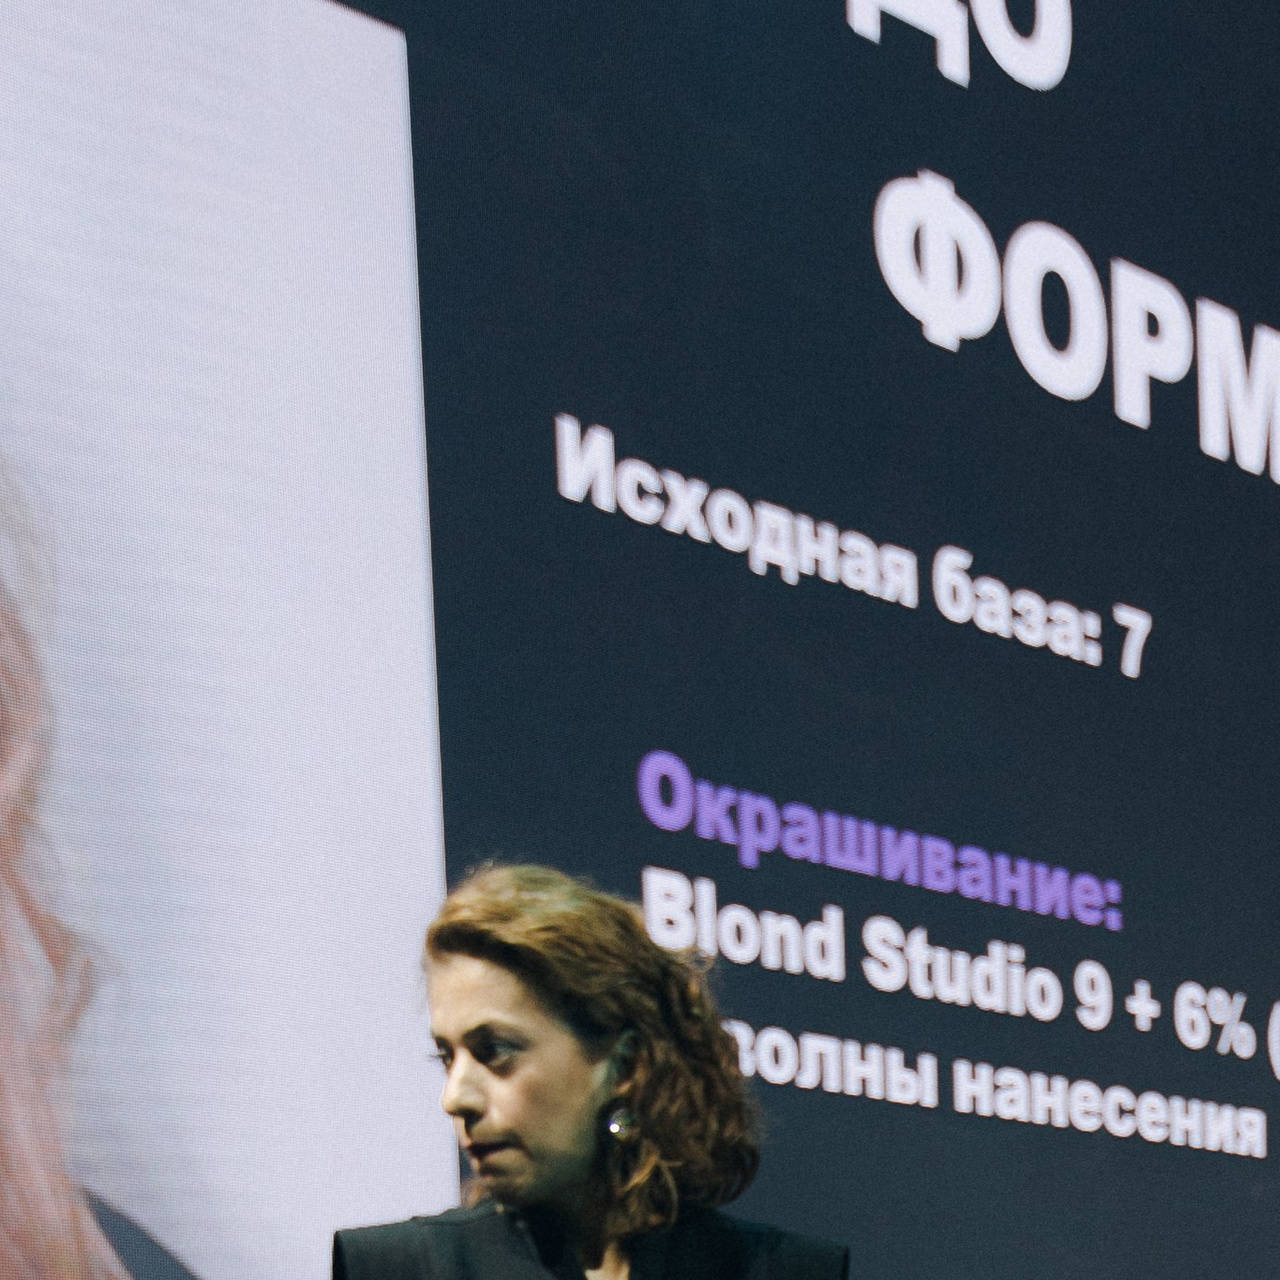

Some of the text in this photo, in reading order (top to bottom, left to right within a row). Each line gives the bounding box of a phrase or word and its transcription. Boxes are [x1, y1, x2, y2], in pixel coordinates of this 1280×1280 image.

[554, 413, 1153, 679] Исходная база: 7
[637, 749, 1123, 931] Окрашивание:
[641, 866, 846, 983] Blond
[861, 916, 1064, 1022] Studio
[1073, 959, 1114, 1032] 9
[1124, 980, 1161, 1032] +
[1173, 981, 1257, 1060] 6%
[952, 1059, 1268, 1159] нанесения
